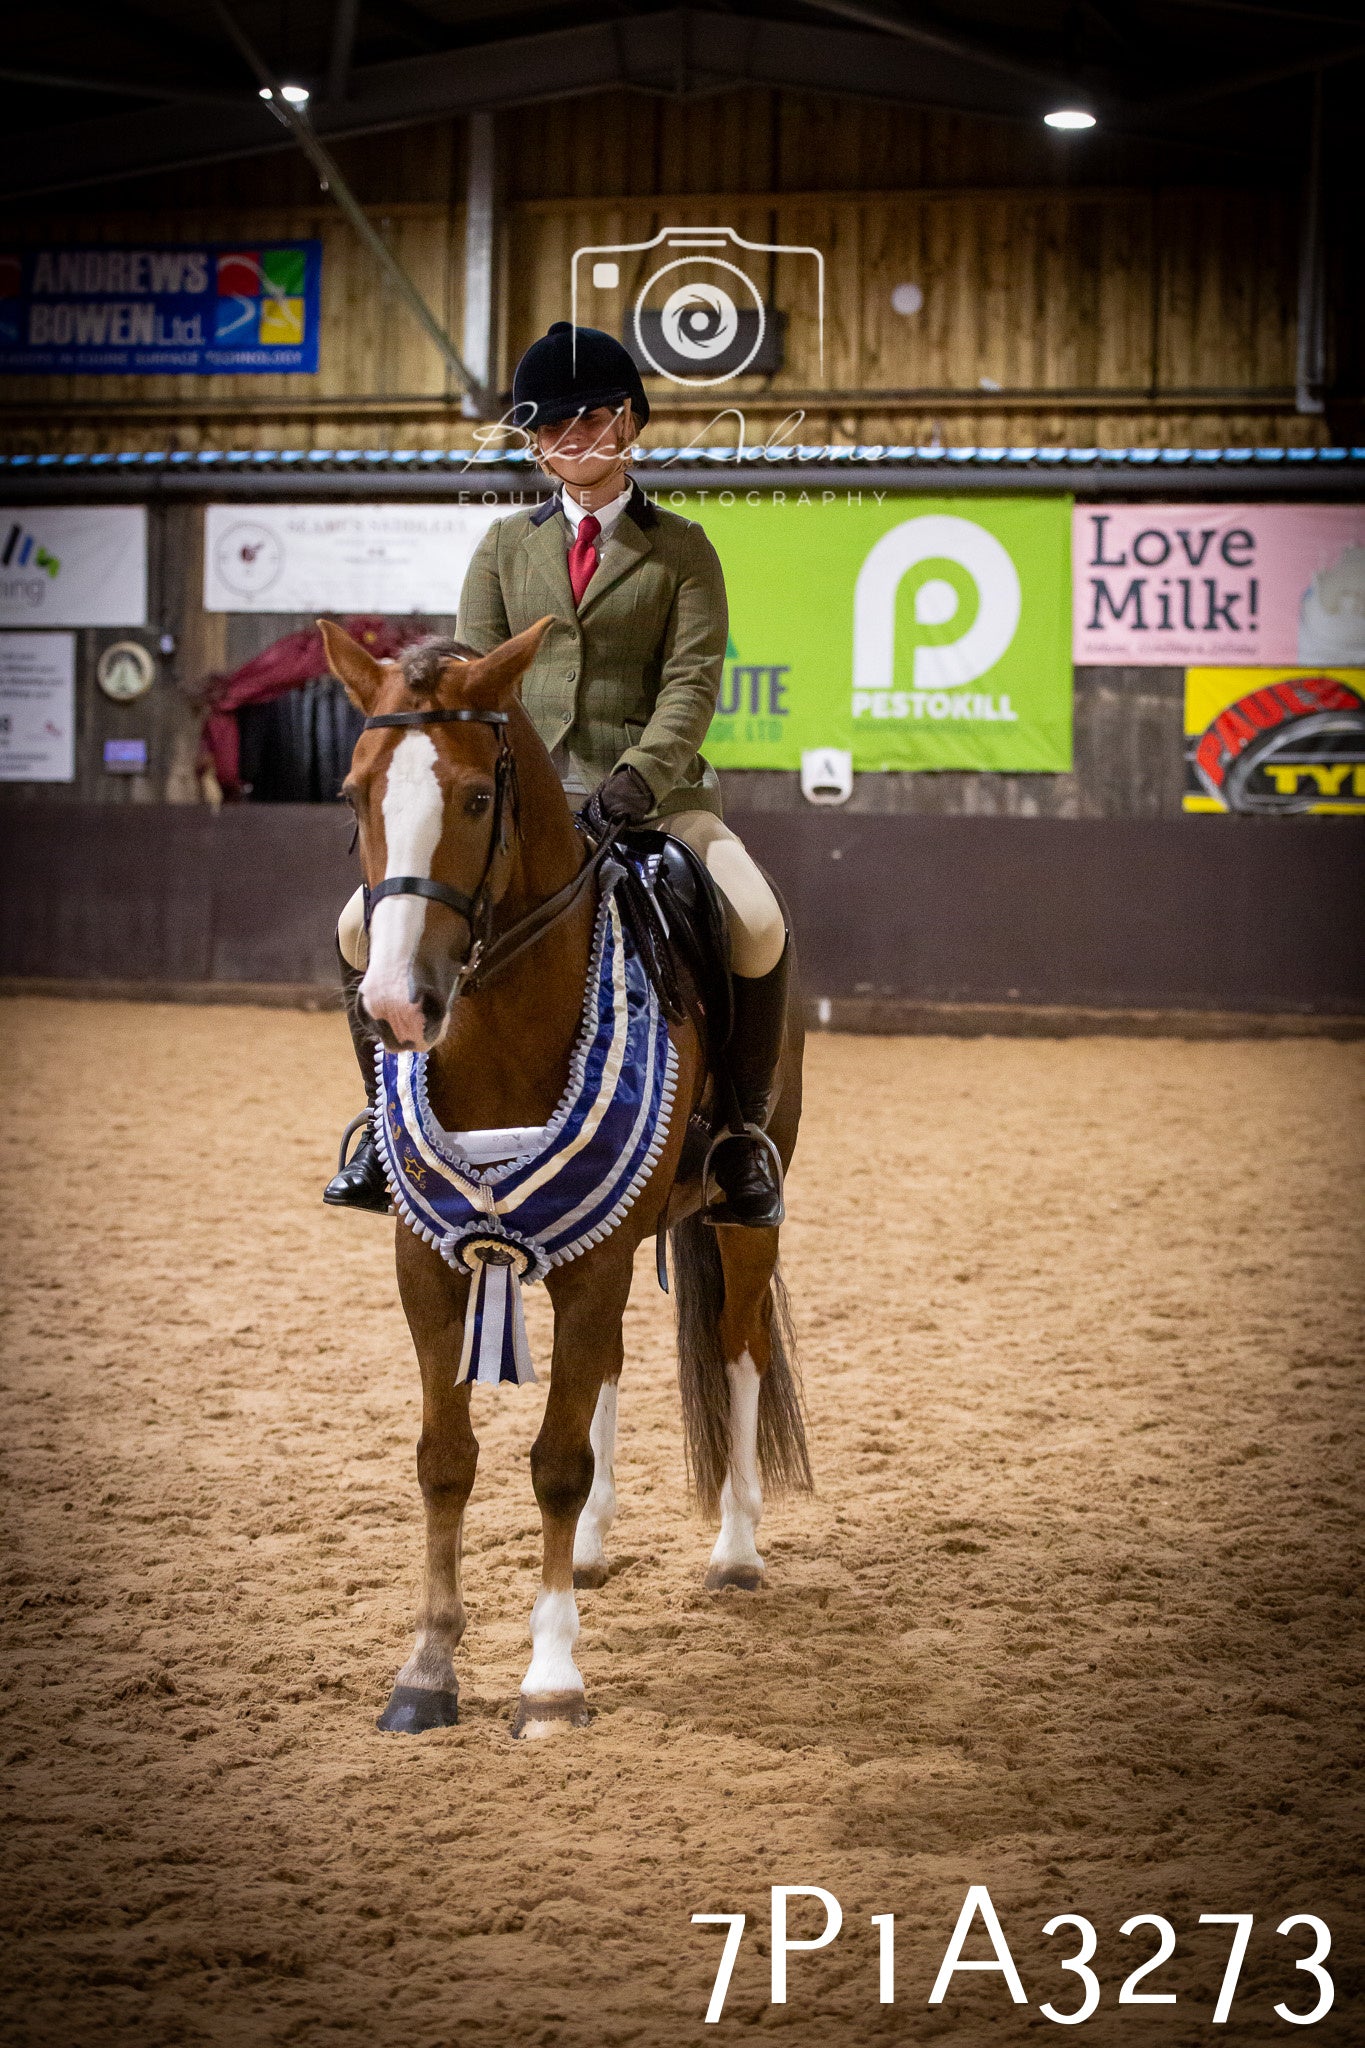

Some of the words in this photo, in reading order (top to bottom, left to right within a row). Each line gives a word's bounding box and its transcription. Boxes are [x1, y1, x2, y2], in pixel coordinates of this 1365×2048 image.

[32, 251, 208, 294] ANDREWS
[28, 302, 155, 346] BOWEN
[1088, 515, 1258, 568] Love
[1086, 577, 1260, 632] Milk!
[852, 691, 1019, 722] PESTOKILL
